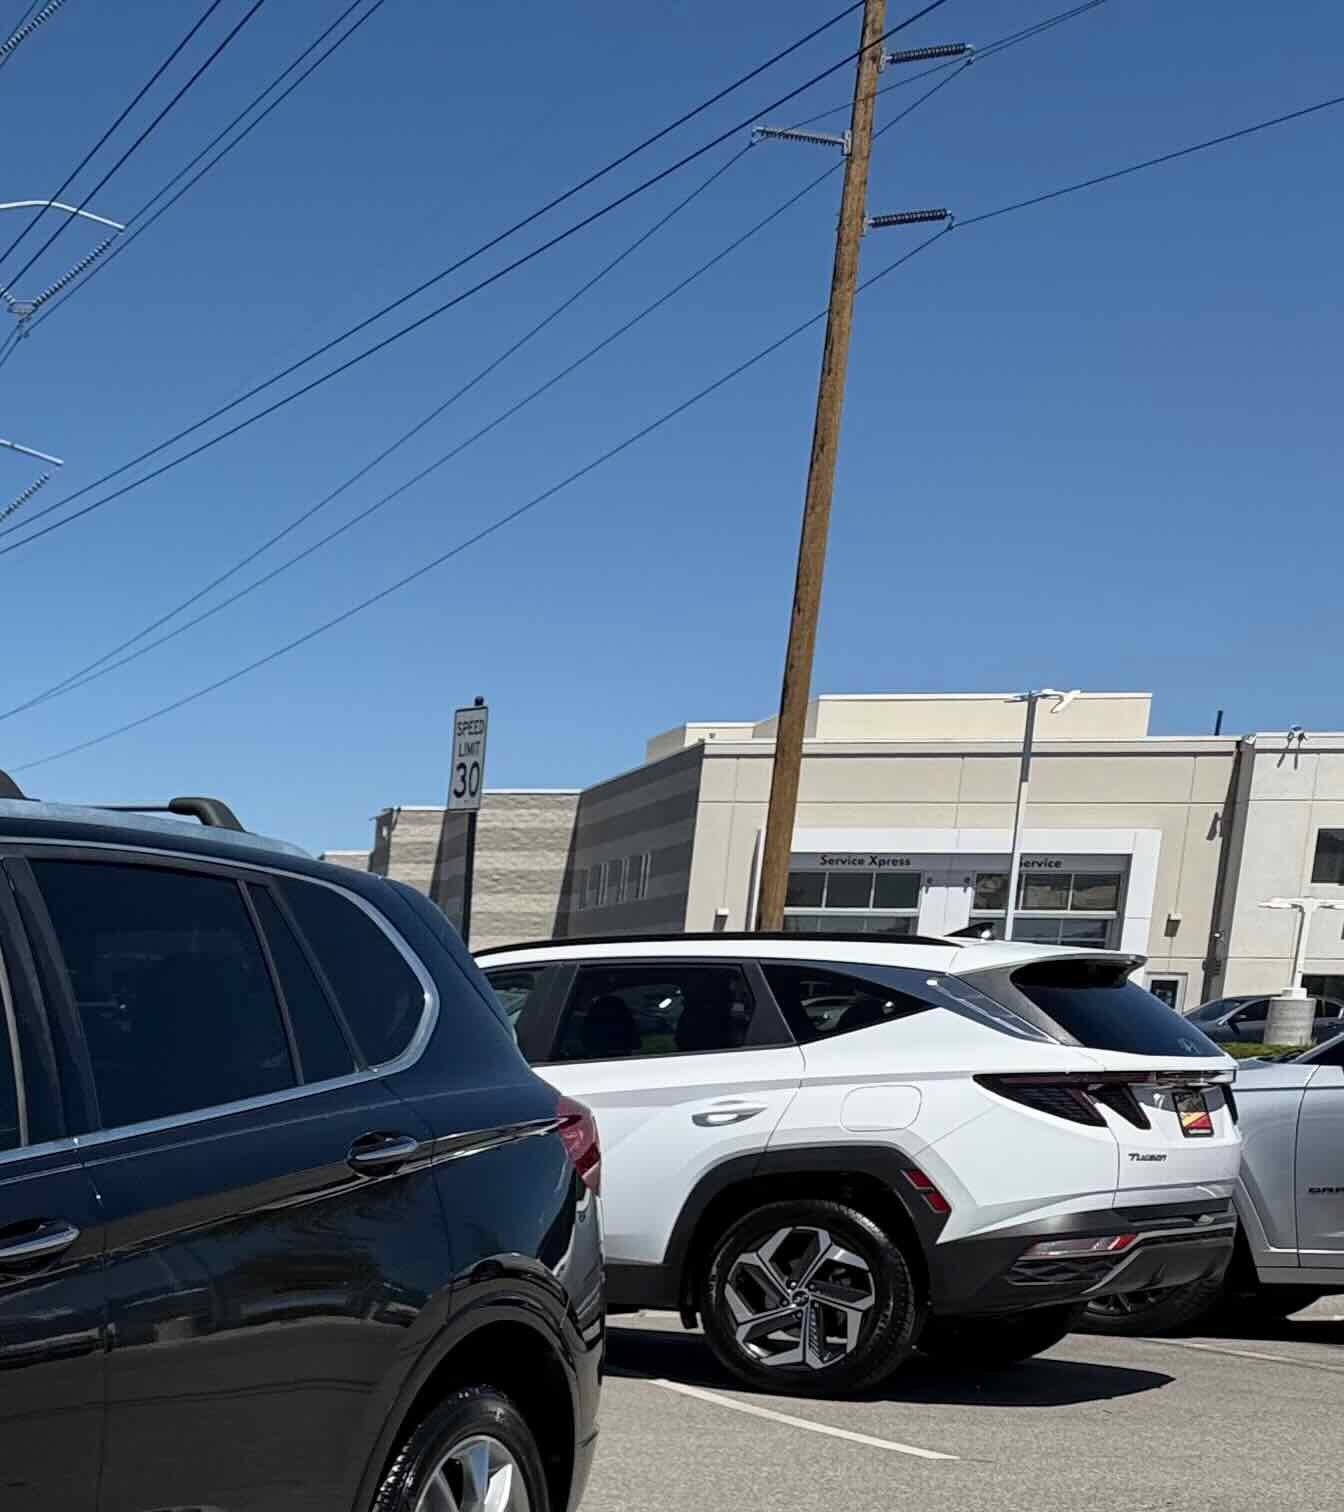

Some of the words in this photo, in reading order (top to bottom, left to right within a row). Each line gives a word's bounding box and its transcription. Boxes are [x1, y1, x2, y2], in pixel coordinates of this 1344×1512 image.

[457, 720, 484, 736] SPEED
[458, 741, 481, 757] LIMIT
[453, 761, 480, 798] 30
[819, 855, 865, 866] Service
[868, 855, 911, 868] Xpress
